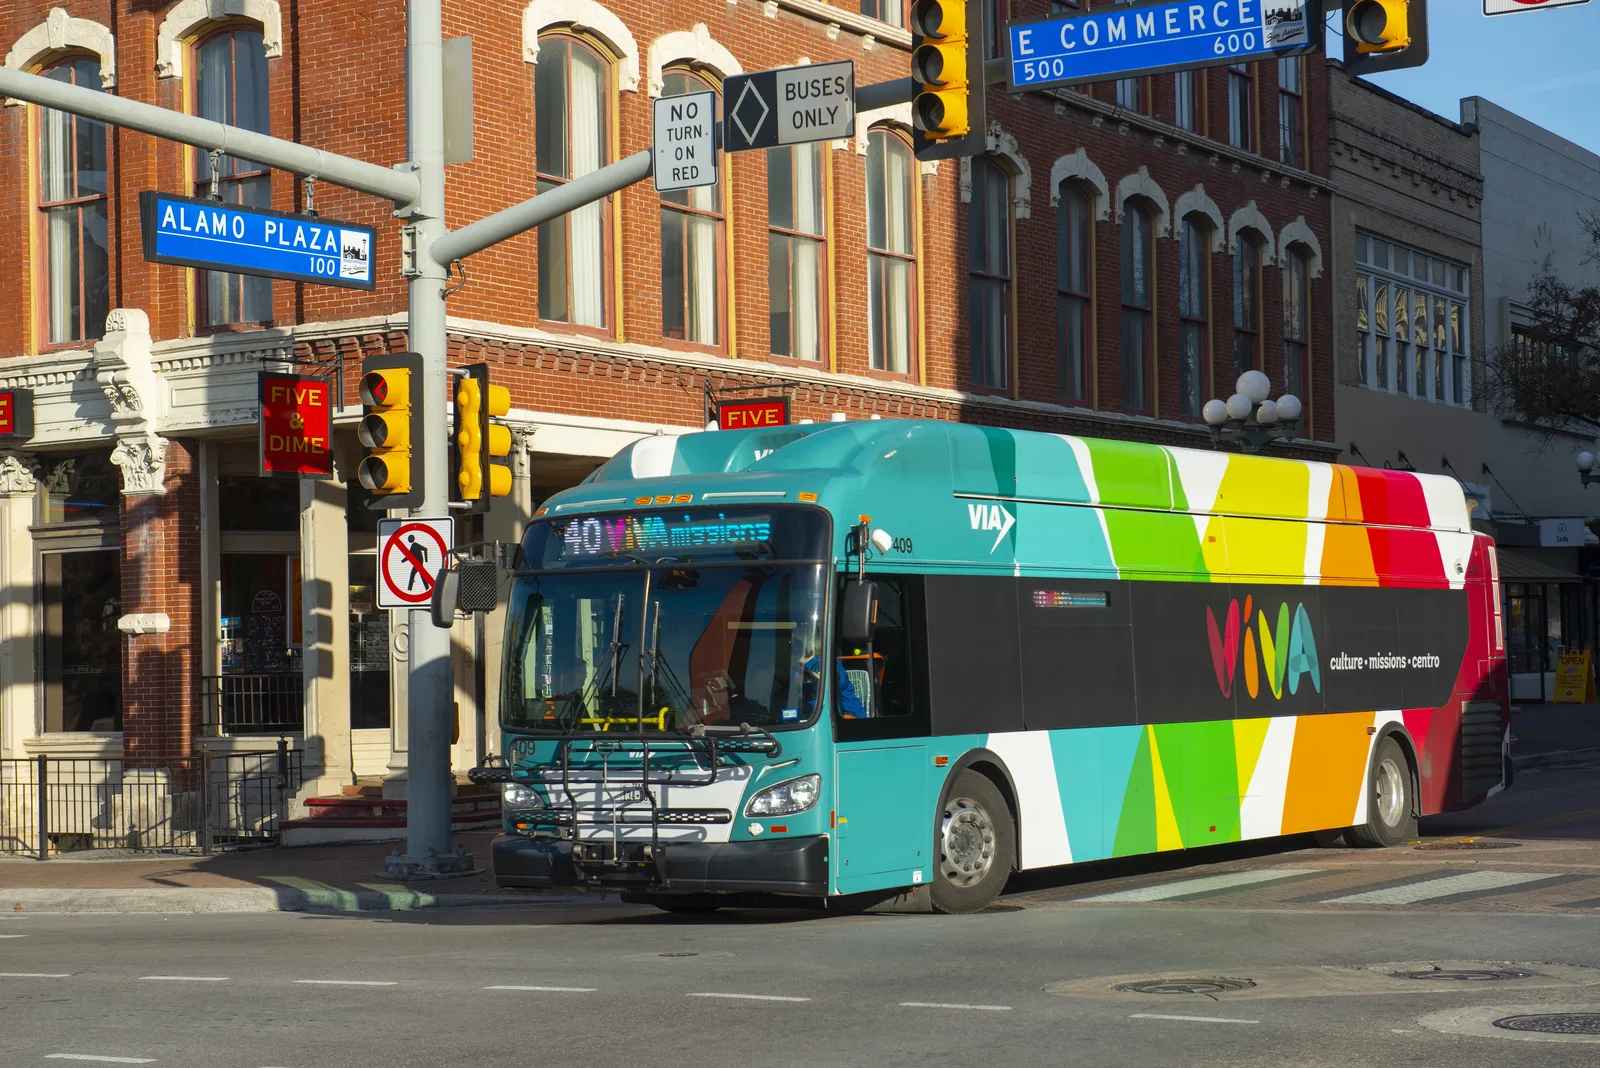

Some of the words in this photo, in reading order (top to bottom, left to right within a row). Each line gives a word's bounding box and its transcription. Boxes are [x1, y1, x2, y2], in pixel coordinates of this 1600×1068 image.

[1019, 30, 1034, 55] E
[1060, 0, 1255, 49] COMMERCE
[1213, 32, 1256, 55] 600
[1024, 58, 1065, 81] 500
[785, 76, 846, 101] BUSES
[670, 102, 699, 122] NO
[792, 105, 839, 129] ONLY
[666, 124, 703, 142] TURN
[673, 145, 697, 163] ON
[672, 166, 699, 183] RED
[161, 205, 246, 240] ALAMO
[264, 219, 339, 253] PLAZA
[310, 257, 337, 276] 100
[271, 385, 322, 407] FIVE
[289, 411, 305, 430] &
[727, 408, 780, 427] FIVE
[269, 434, 325, 455] DIME
[967, 503, 1003, 531] VIA
[564, 517, 601, 554] 40
[669, 513, 771, 547] missions
[892, 536, 914, 555] 409
[1330, 651, 1363, 671] culture
[1368, 651, 1407, 670] missions
[1411, 652, 1440, 669] centro
[1561, 656, 1584, 665] OPEN
